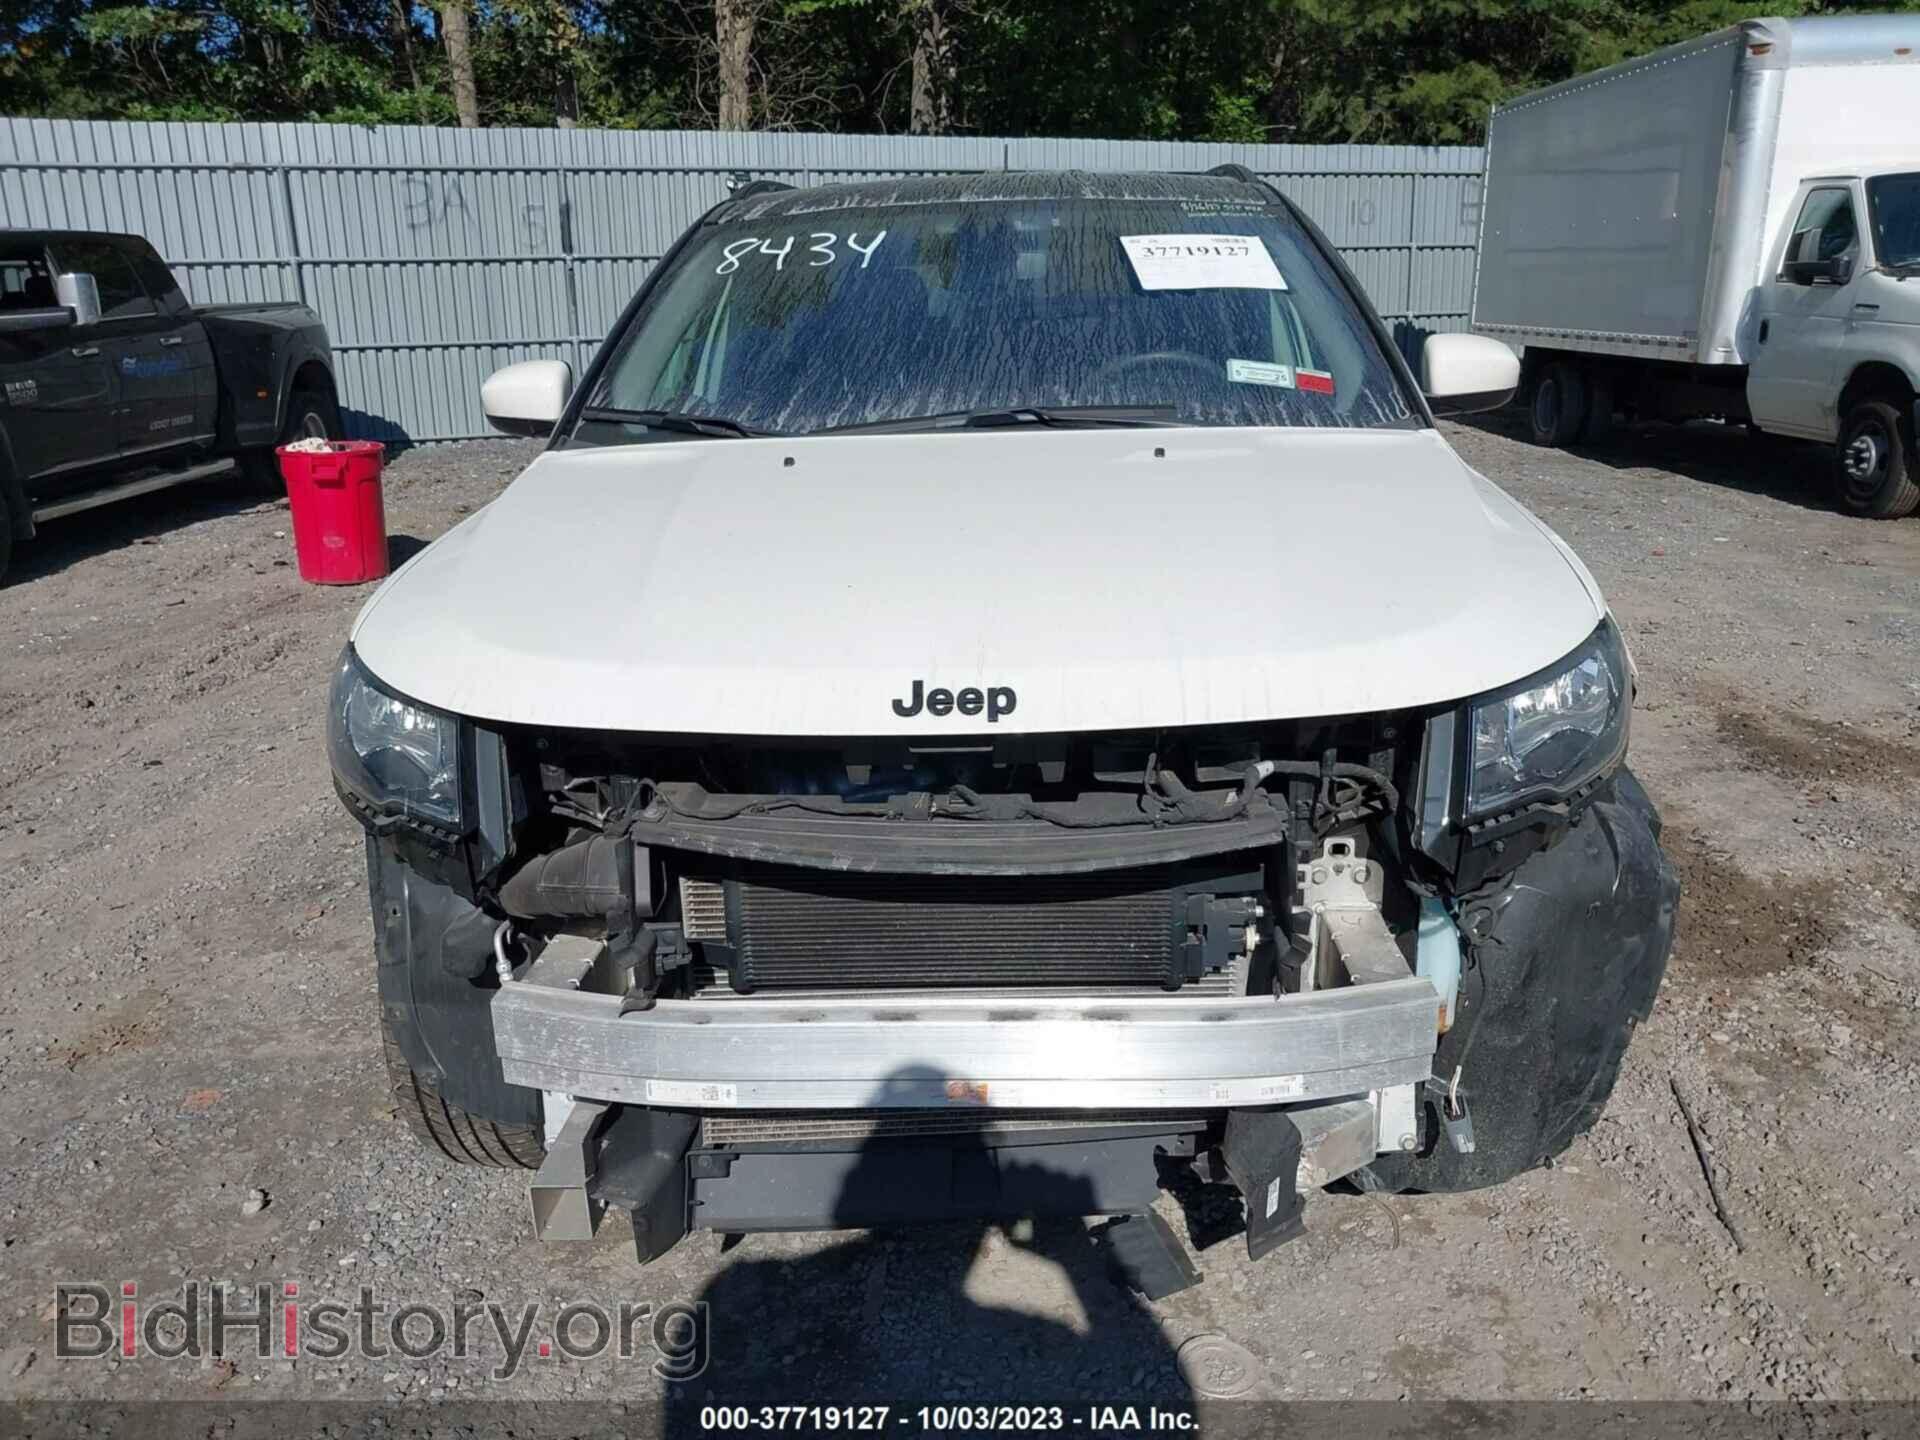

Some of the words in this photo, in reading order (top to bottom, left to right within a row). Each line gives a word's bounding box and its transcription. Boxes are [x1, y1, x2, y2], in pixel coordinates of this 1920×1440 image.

[715, 230, 888, 275] 8434
[1142, 246, 1249, 257] 37719127
[892, 680, 1017, 723] Jeep
